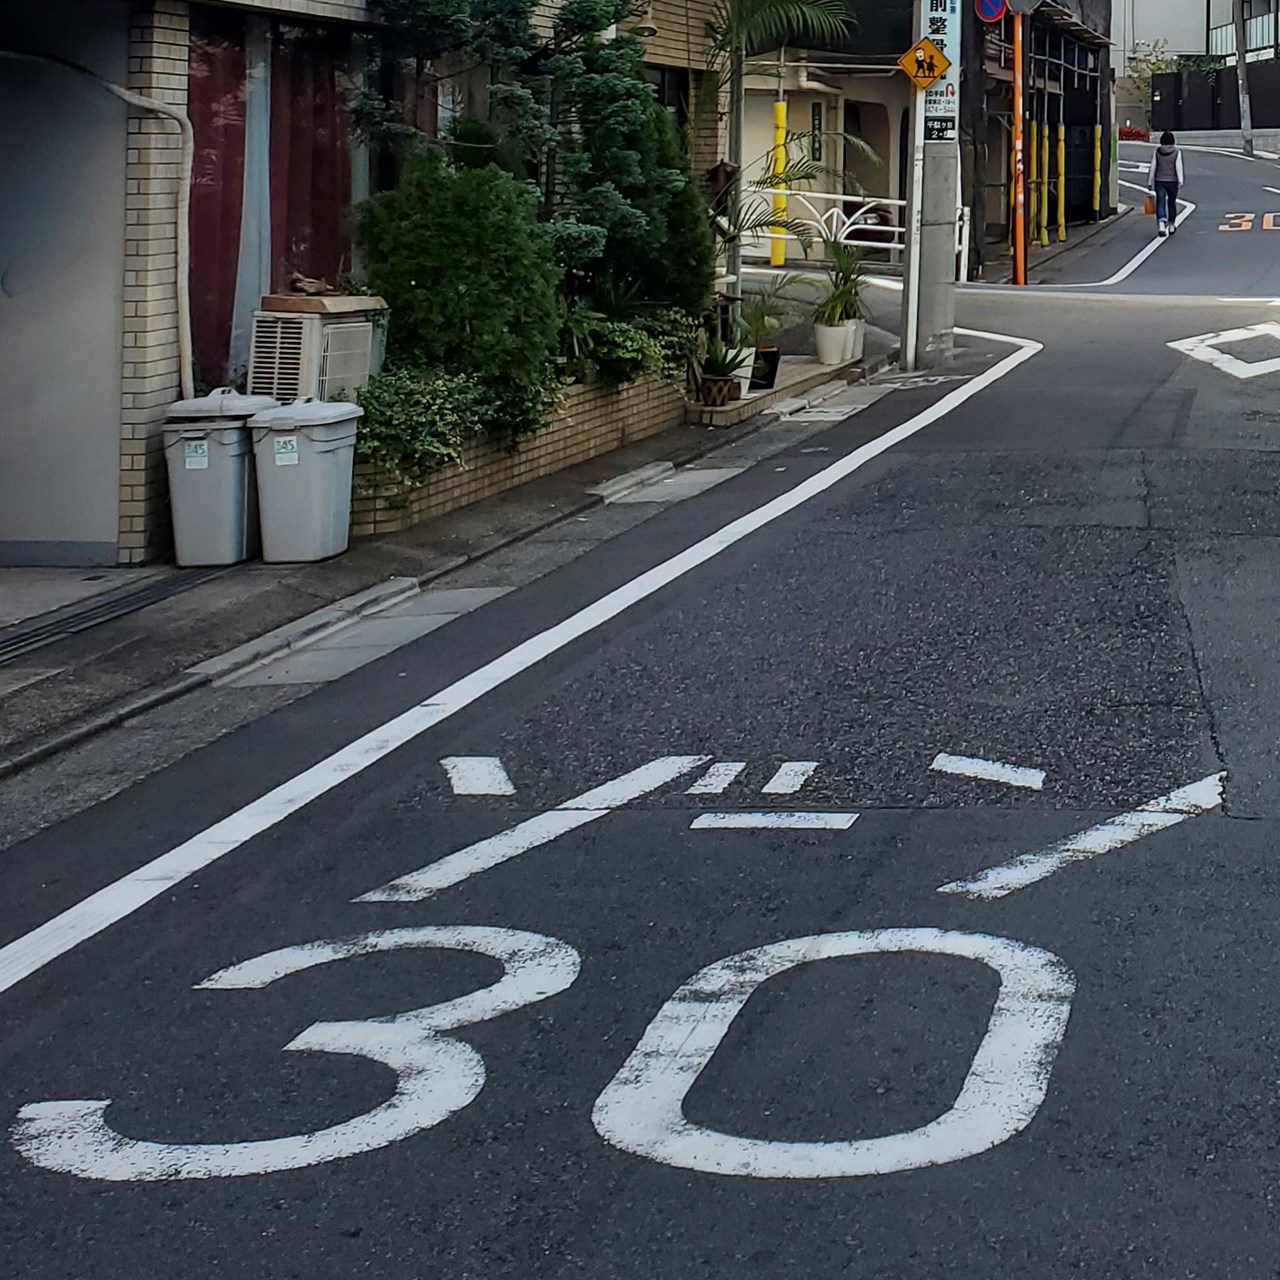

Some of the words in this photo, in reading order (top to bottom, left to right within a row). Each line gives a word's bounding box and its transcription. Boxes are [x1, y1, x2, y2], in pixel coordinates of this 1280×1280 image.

[352, 754, 1226, 903] ゾーン
[12, 926, 1078, 1181] 30
